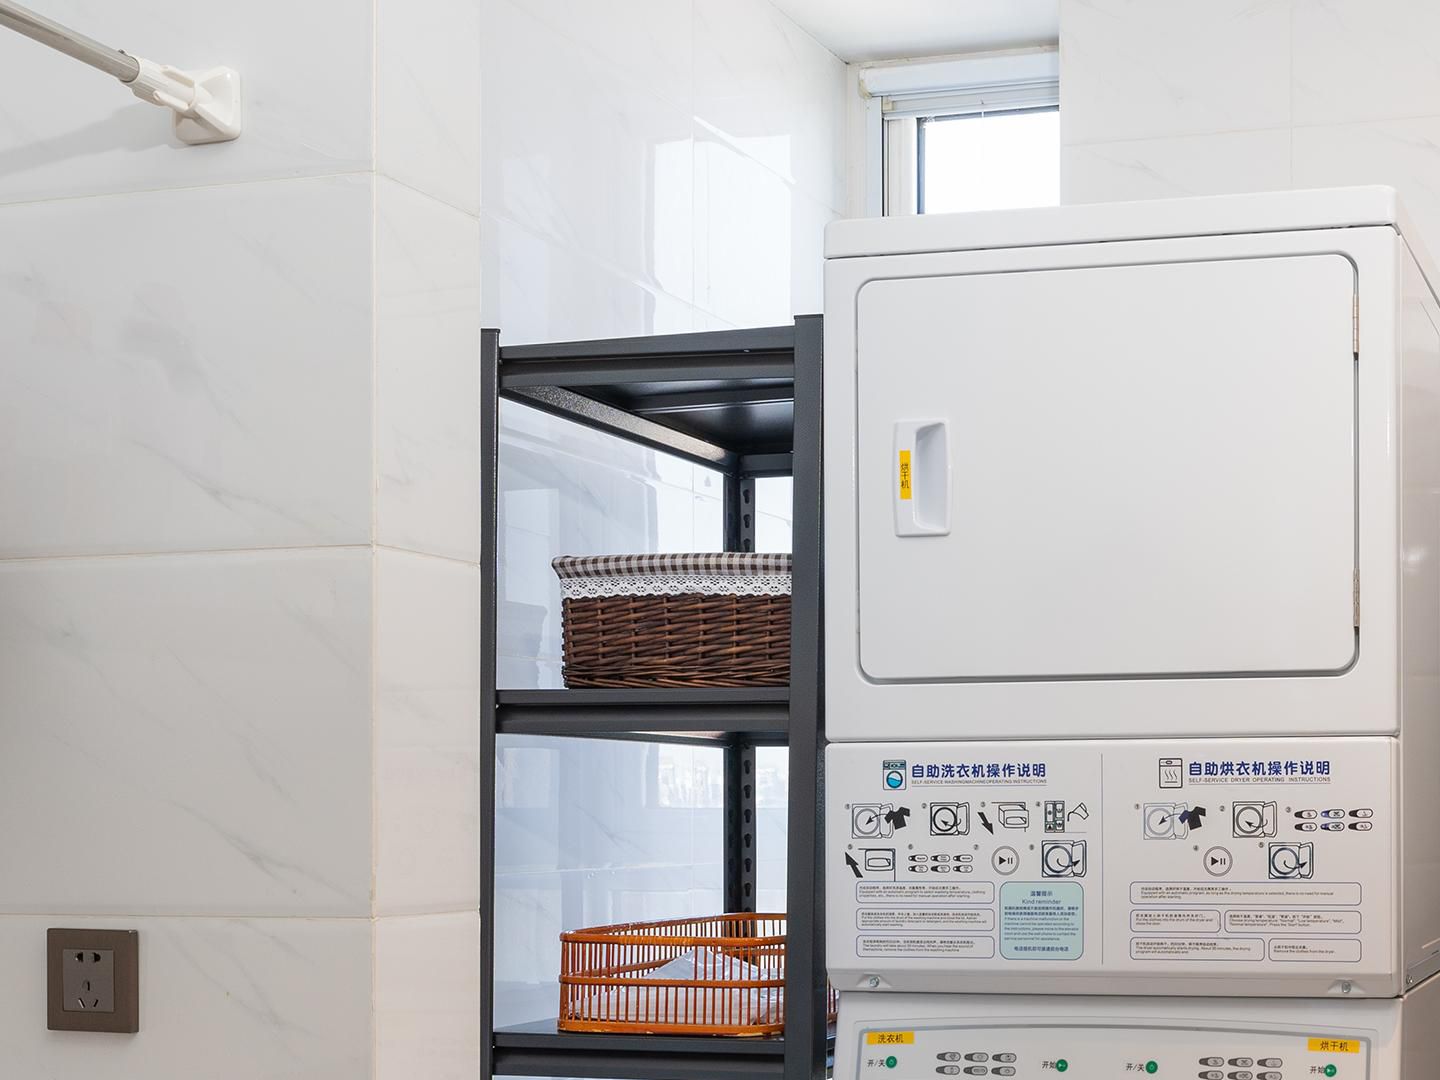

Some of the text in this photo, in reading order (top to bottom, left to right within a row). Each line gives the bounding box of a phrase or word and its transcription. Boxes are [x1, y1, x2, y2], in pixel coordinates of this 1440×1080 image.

[911, 763, 1046, 778] 自助洗衣机操作说明
[1189, 760, 1330, 776] 自助烘衣机操作说明
[877, 1033, 904, 1044] 洗衣机
[1320, 1041, 1349, 1052] 烘干机
[867, 1058, 886, 1068] 开/关
[1041, 1061, 1056, 1070] 开始
[1125, 1063, 1145, 1072] 开/关
[1309, 1066, 1325, 1075] 开始
